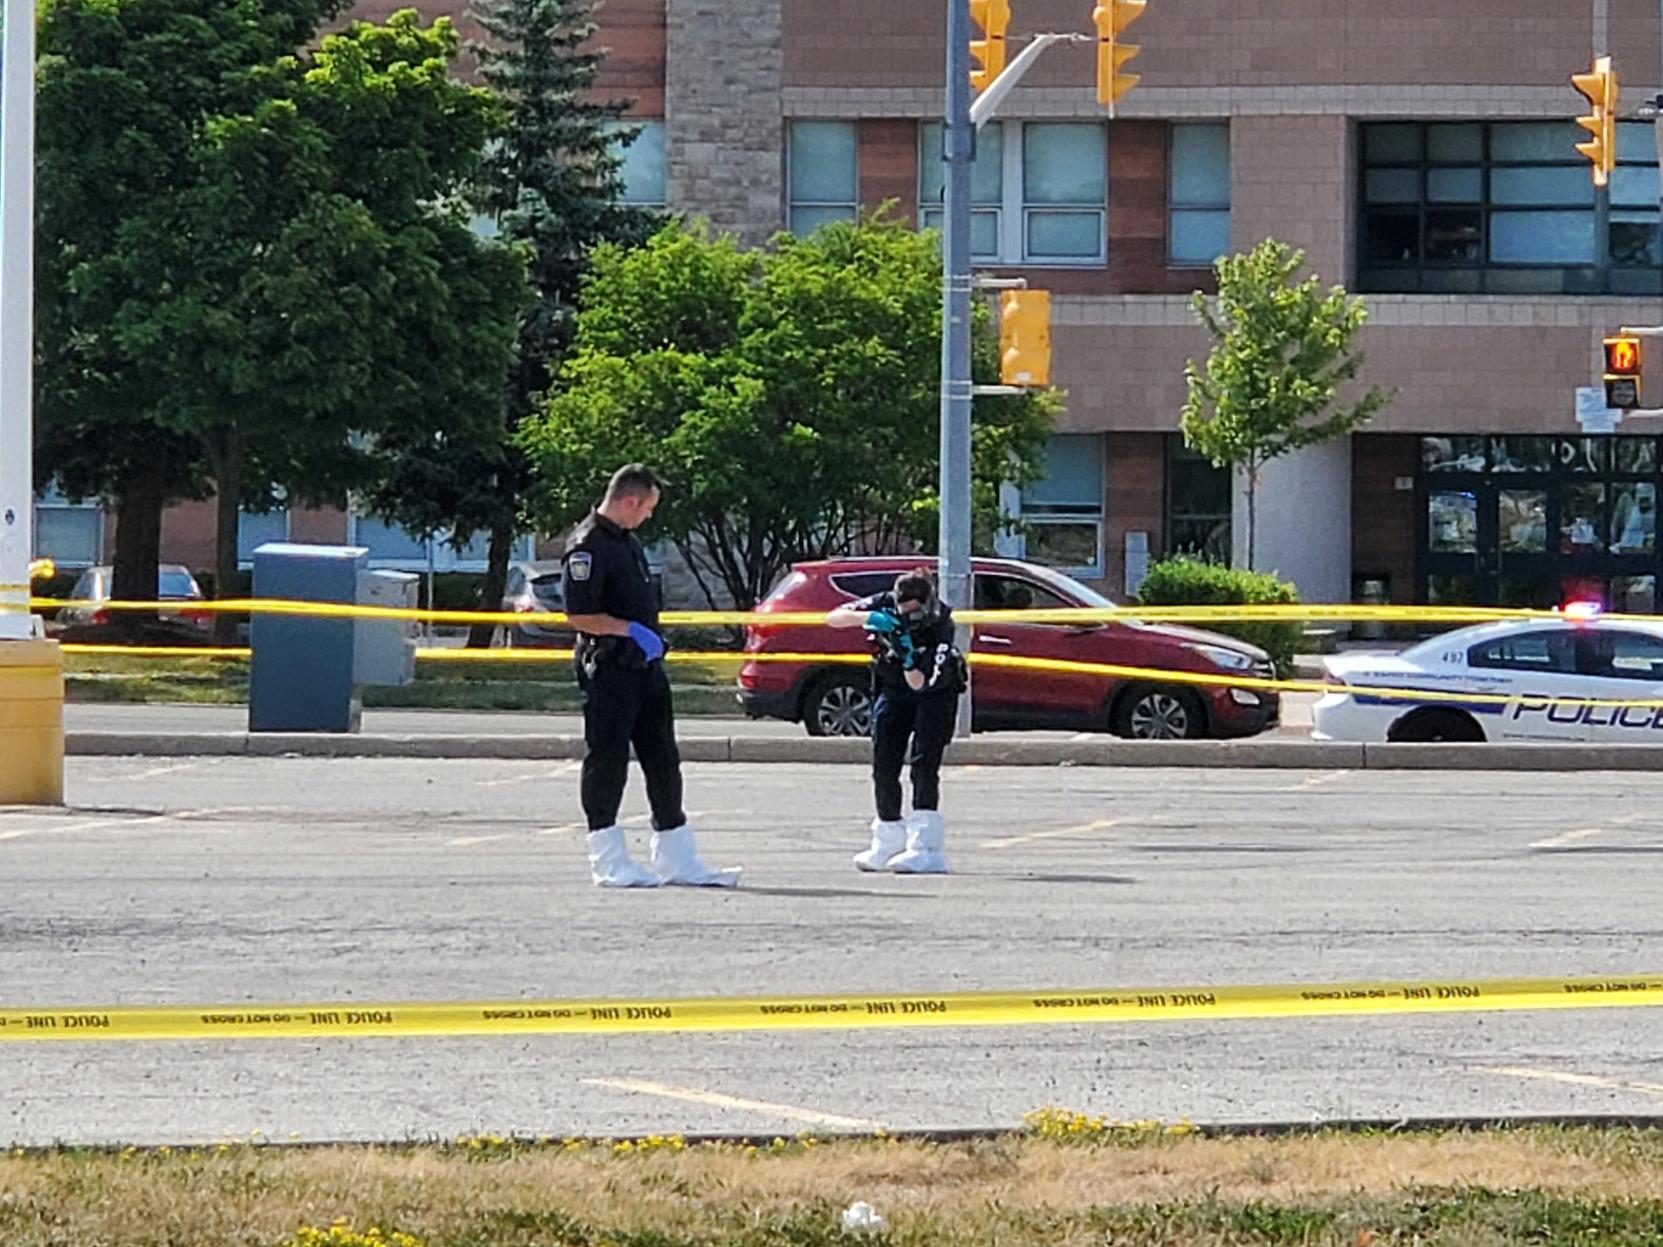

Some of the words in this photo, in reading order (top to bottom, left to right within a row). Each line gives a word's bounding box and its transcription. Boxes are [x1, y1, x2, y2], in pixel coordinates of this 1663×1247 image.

[1441, 651, 1464, 664] 497
[1404, 987, 1431, 998] LINE
[1436, 986, 1480, 998] POLICE
[1136, 995, 1166, 1006] LINE
[1171, 994, 1215, 1005] POLICE
[866, 1002, 895, 1013] LINE
[901, 1001, 946, 1012] POLICE
[310, 1012, 339, 1024] LINE
[347, 1012, 392, 1024] POLICE
[590, 1008, 619, 1019] LINE
[627, 1007, 671, 1019] POLICE
[26, 1016, 56, 1028] LINE
[63, 1015, 109, 1027] POLICE
[201, 1015, 244, 1024] CROSS
